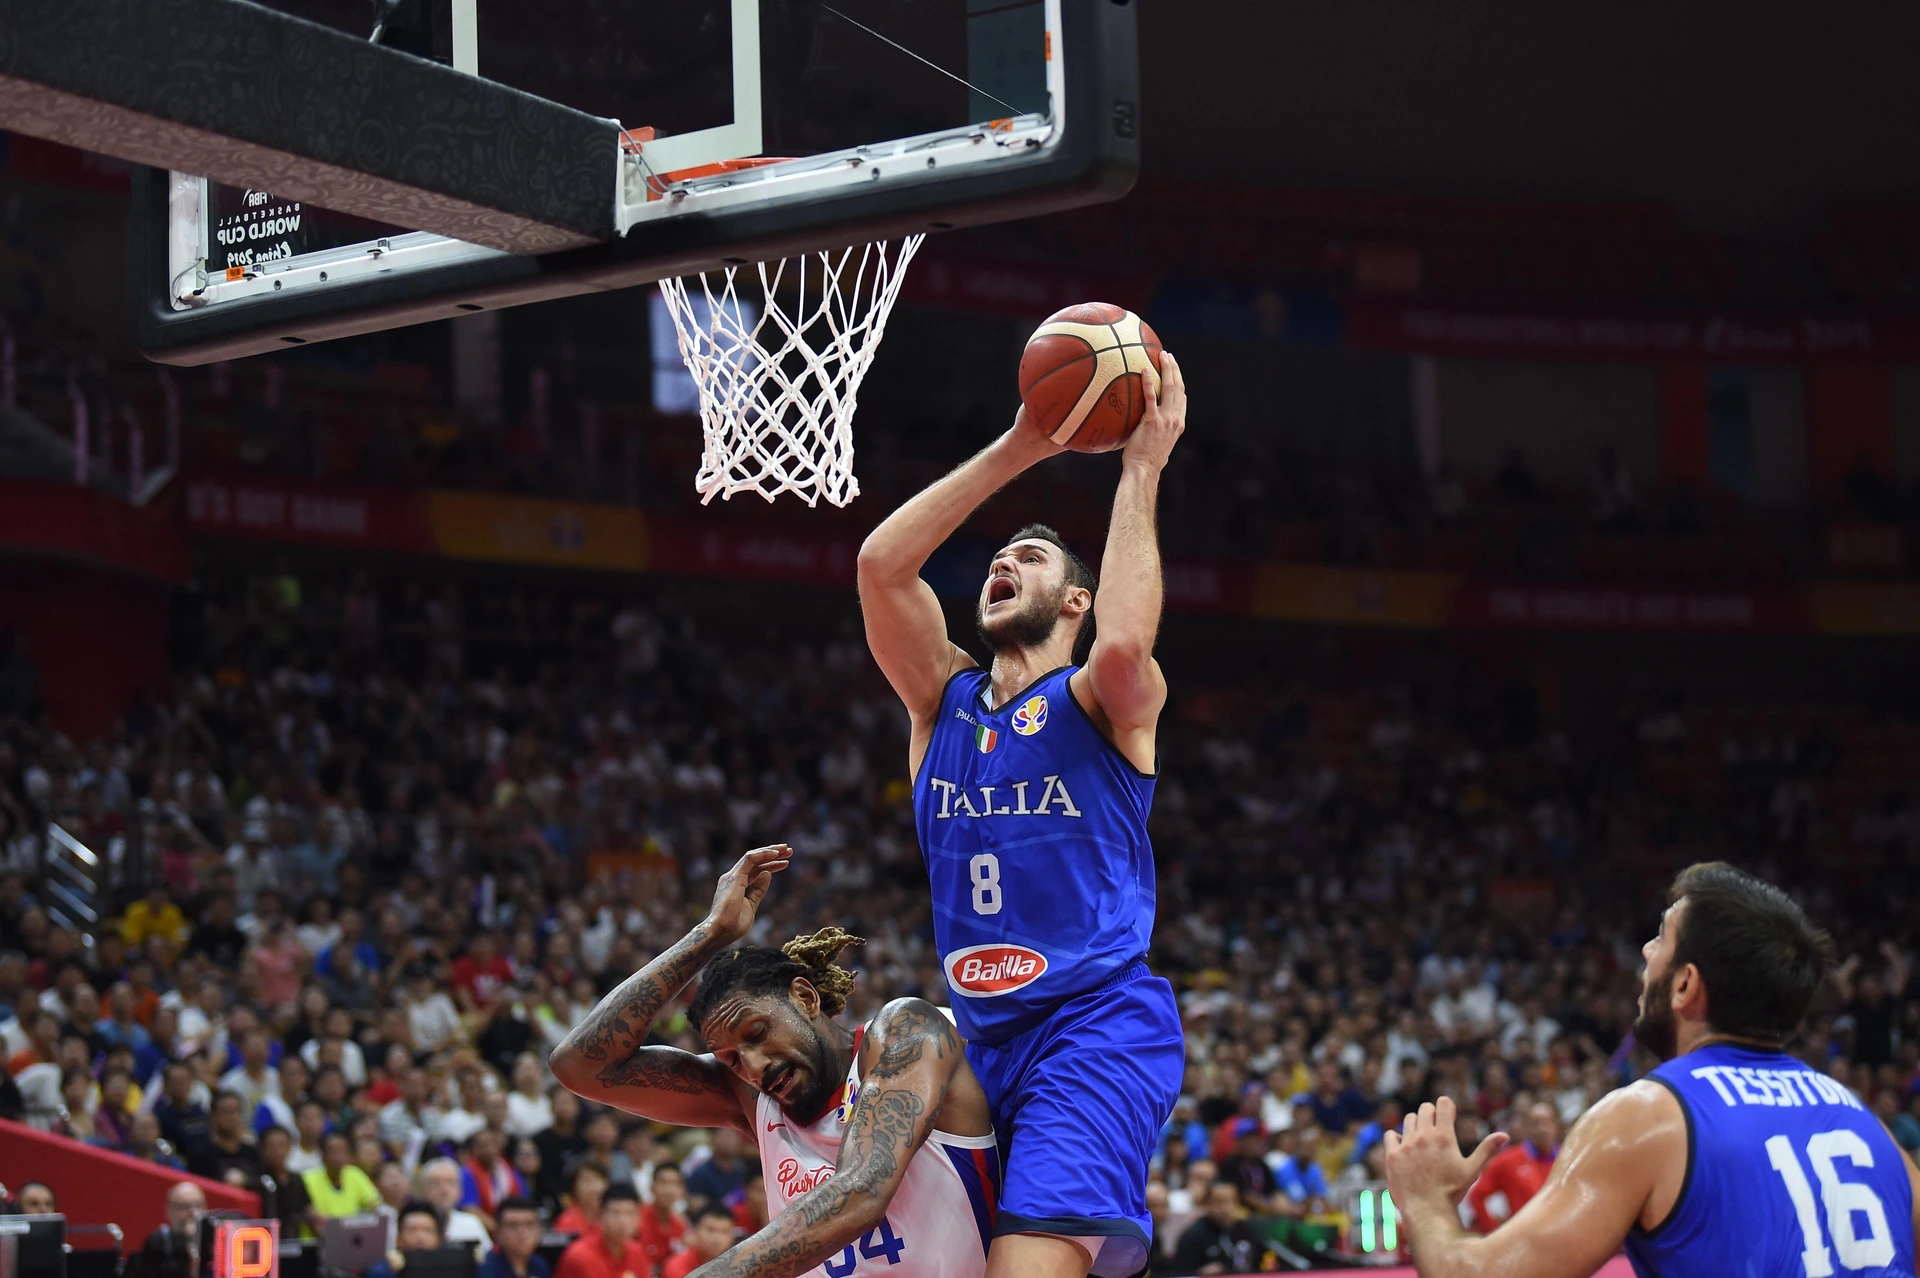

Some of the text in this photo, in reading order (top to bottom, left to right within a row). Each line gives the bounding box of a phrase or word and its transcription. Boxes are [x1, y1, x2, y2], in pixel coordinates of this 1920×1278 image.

[969, 853, 1003, 915] 8
[961, 955, 1037, 983] Barilla
[1764, 1129, 1896, 1278] 16
